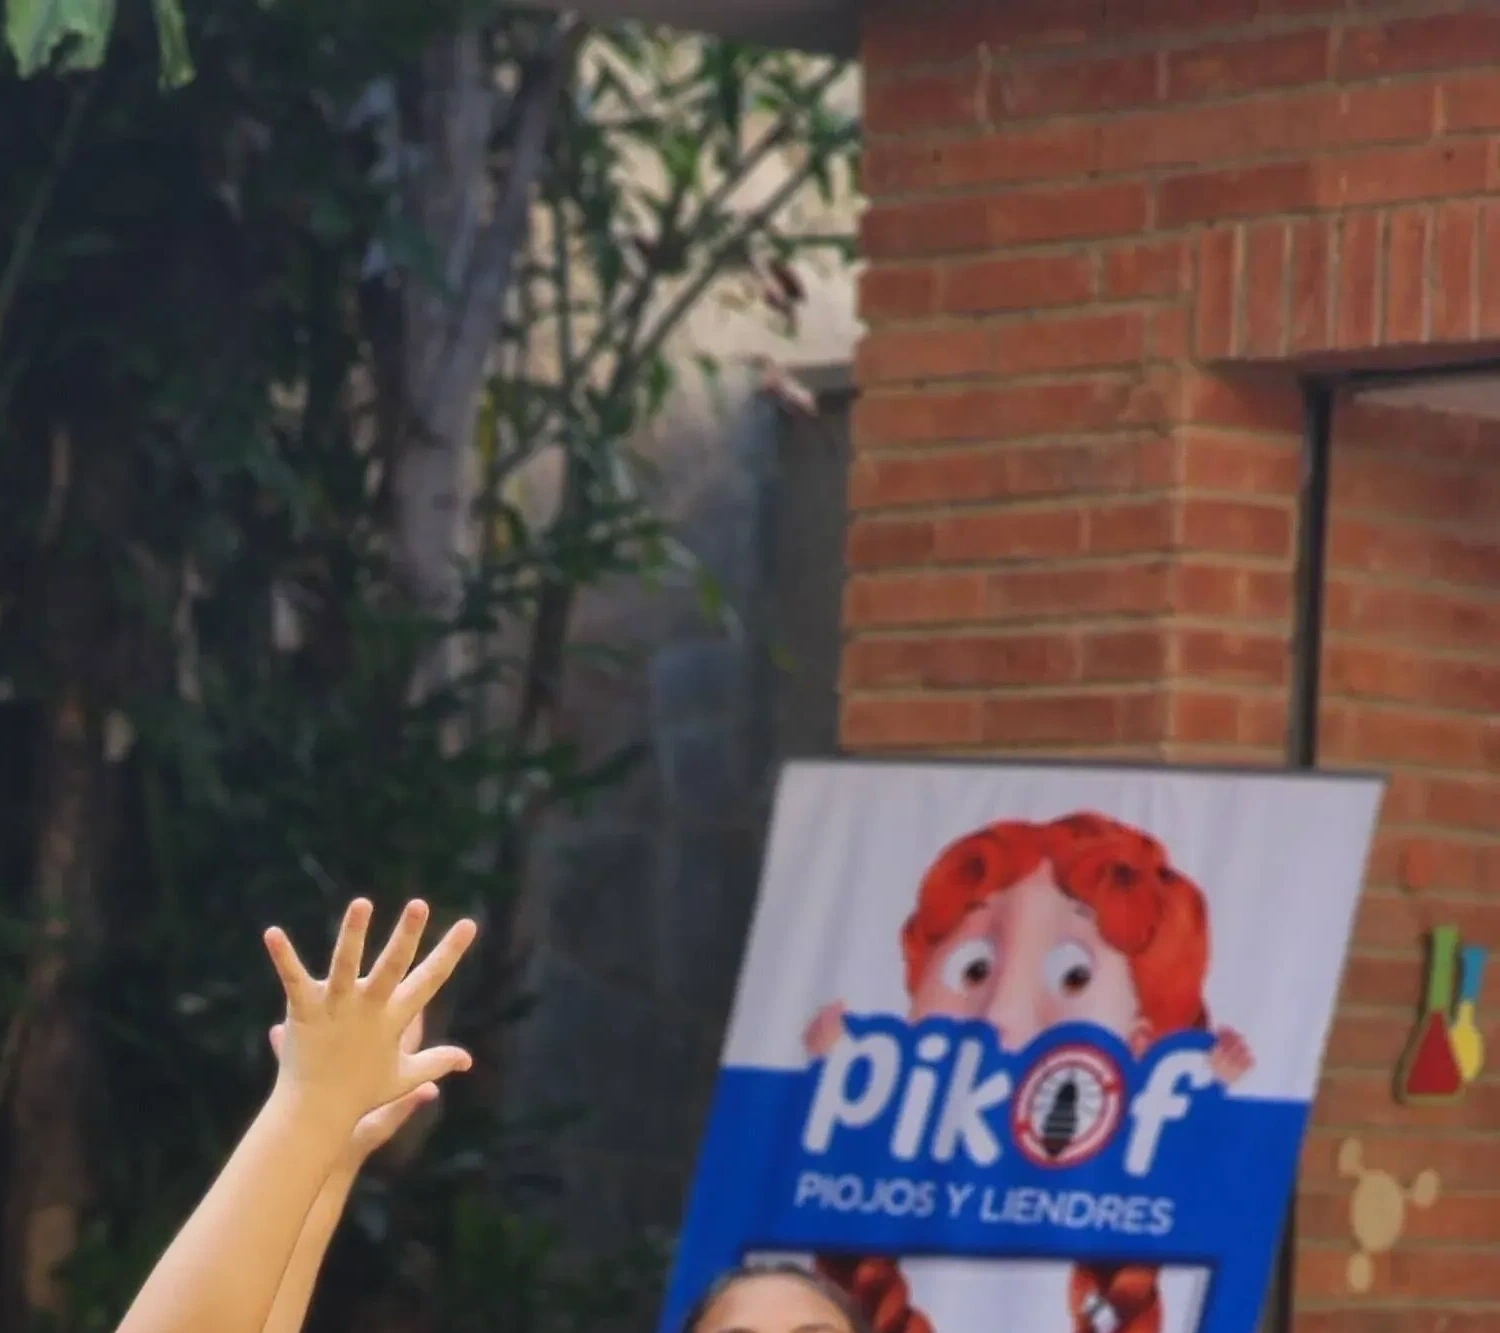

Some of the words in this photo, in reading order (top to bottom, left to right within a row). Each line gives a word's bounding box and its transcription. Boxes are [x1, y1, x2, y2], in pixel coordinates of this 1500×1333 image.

[795, 1171, 937, 1217] PIOJOS
[946, 1181, 975, 1220] Y
[979, 1186, 1177, 1236] LIENDRES
